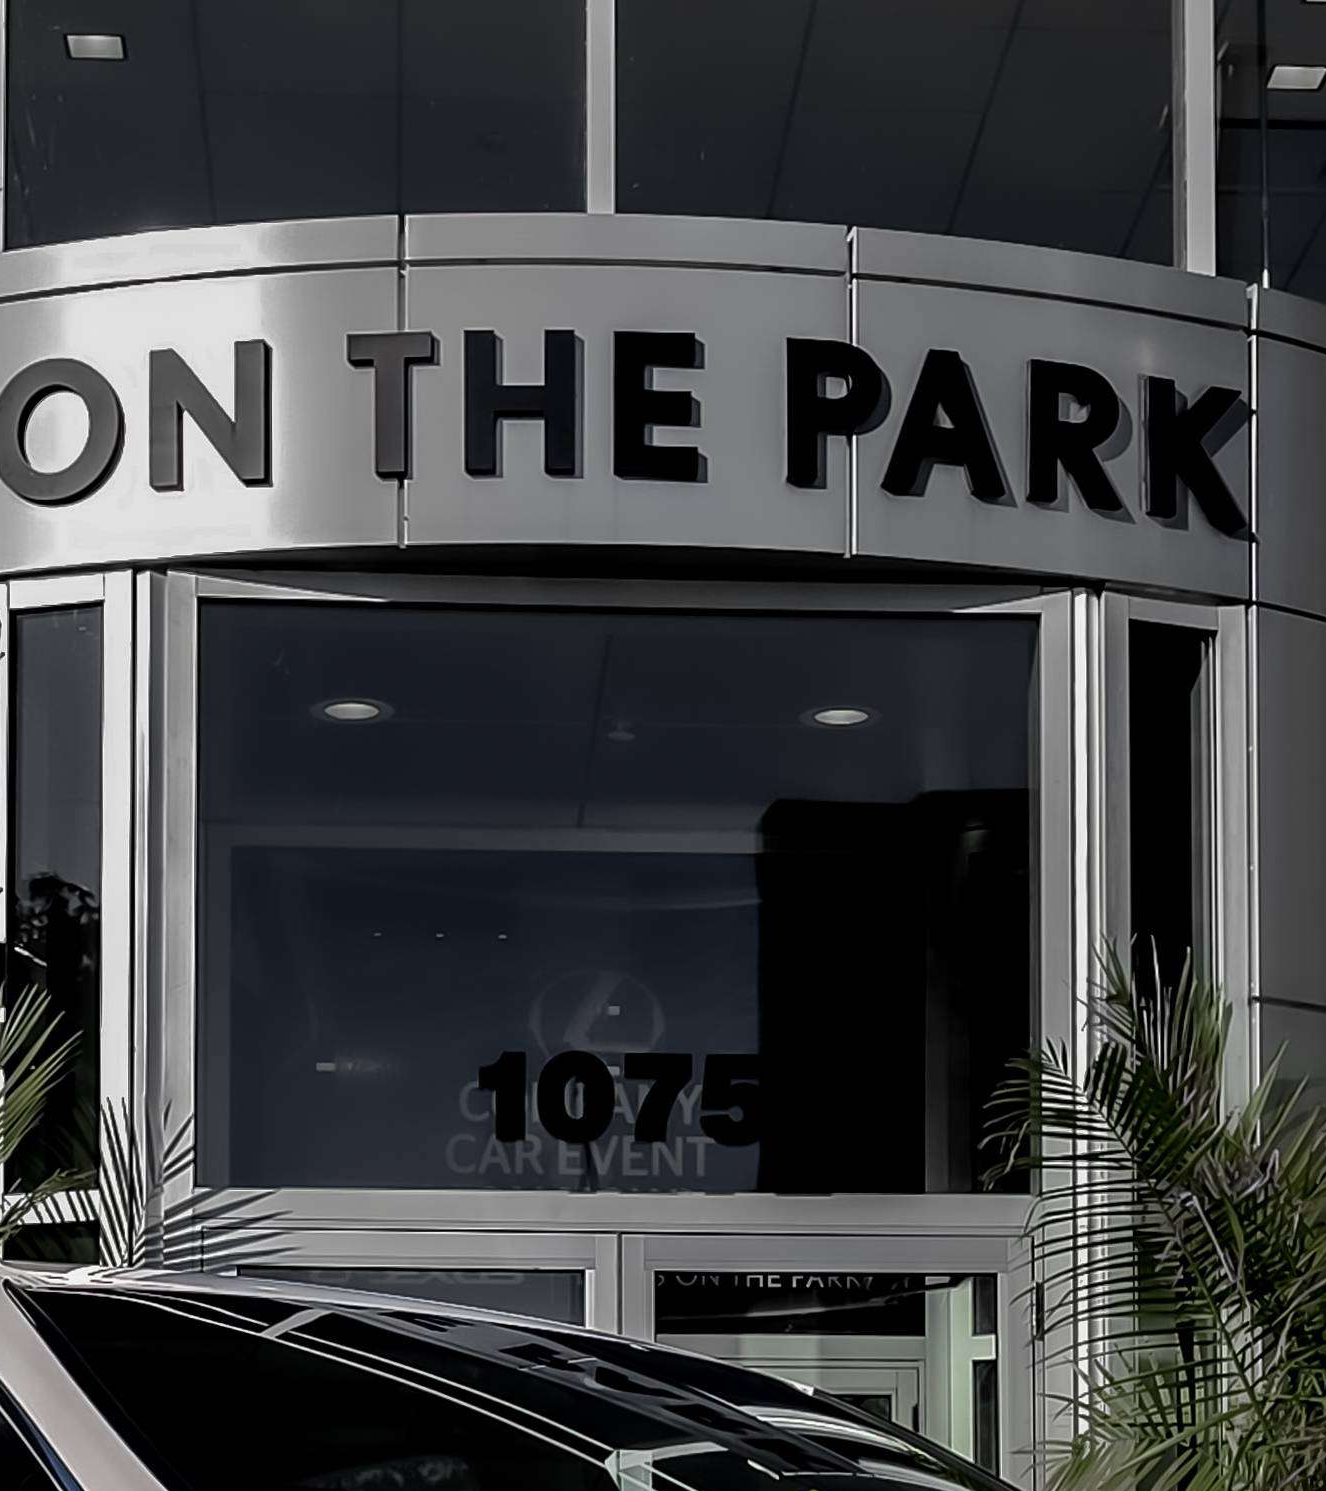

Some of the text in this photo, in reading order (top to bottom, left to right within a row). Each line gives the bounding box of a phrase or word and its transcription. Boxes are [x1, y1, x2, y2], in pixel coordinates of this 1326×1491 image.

[347, 328, 707, 487] THE
[785, 336, 1256, 543] PARK
[478, 1050, 761, 1148] 1075
[444, 1133, 716, 1178] CAR EVENT
